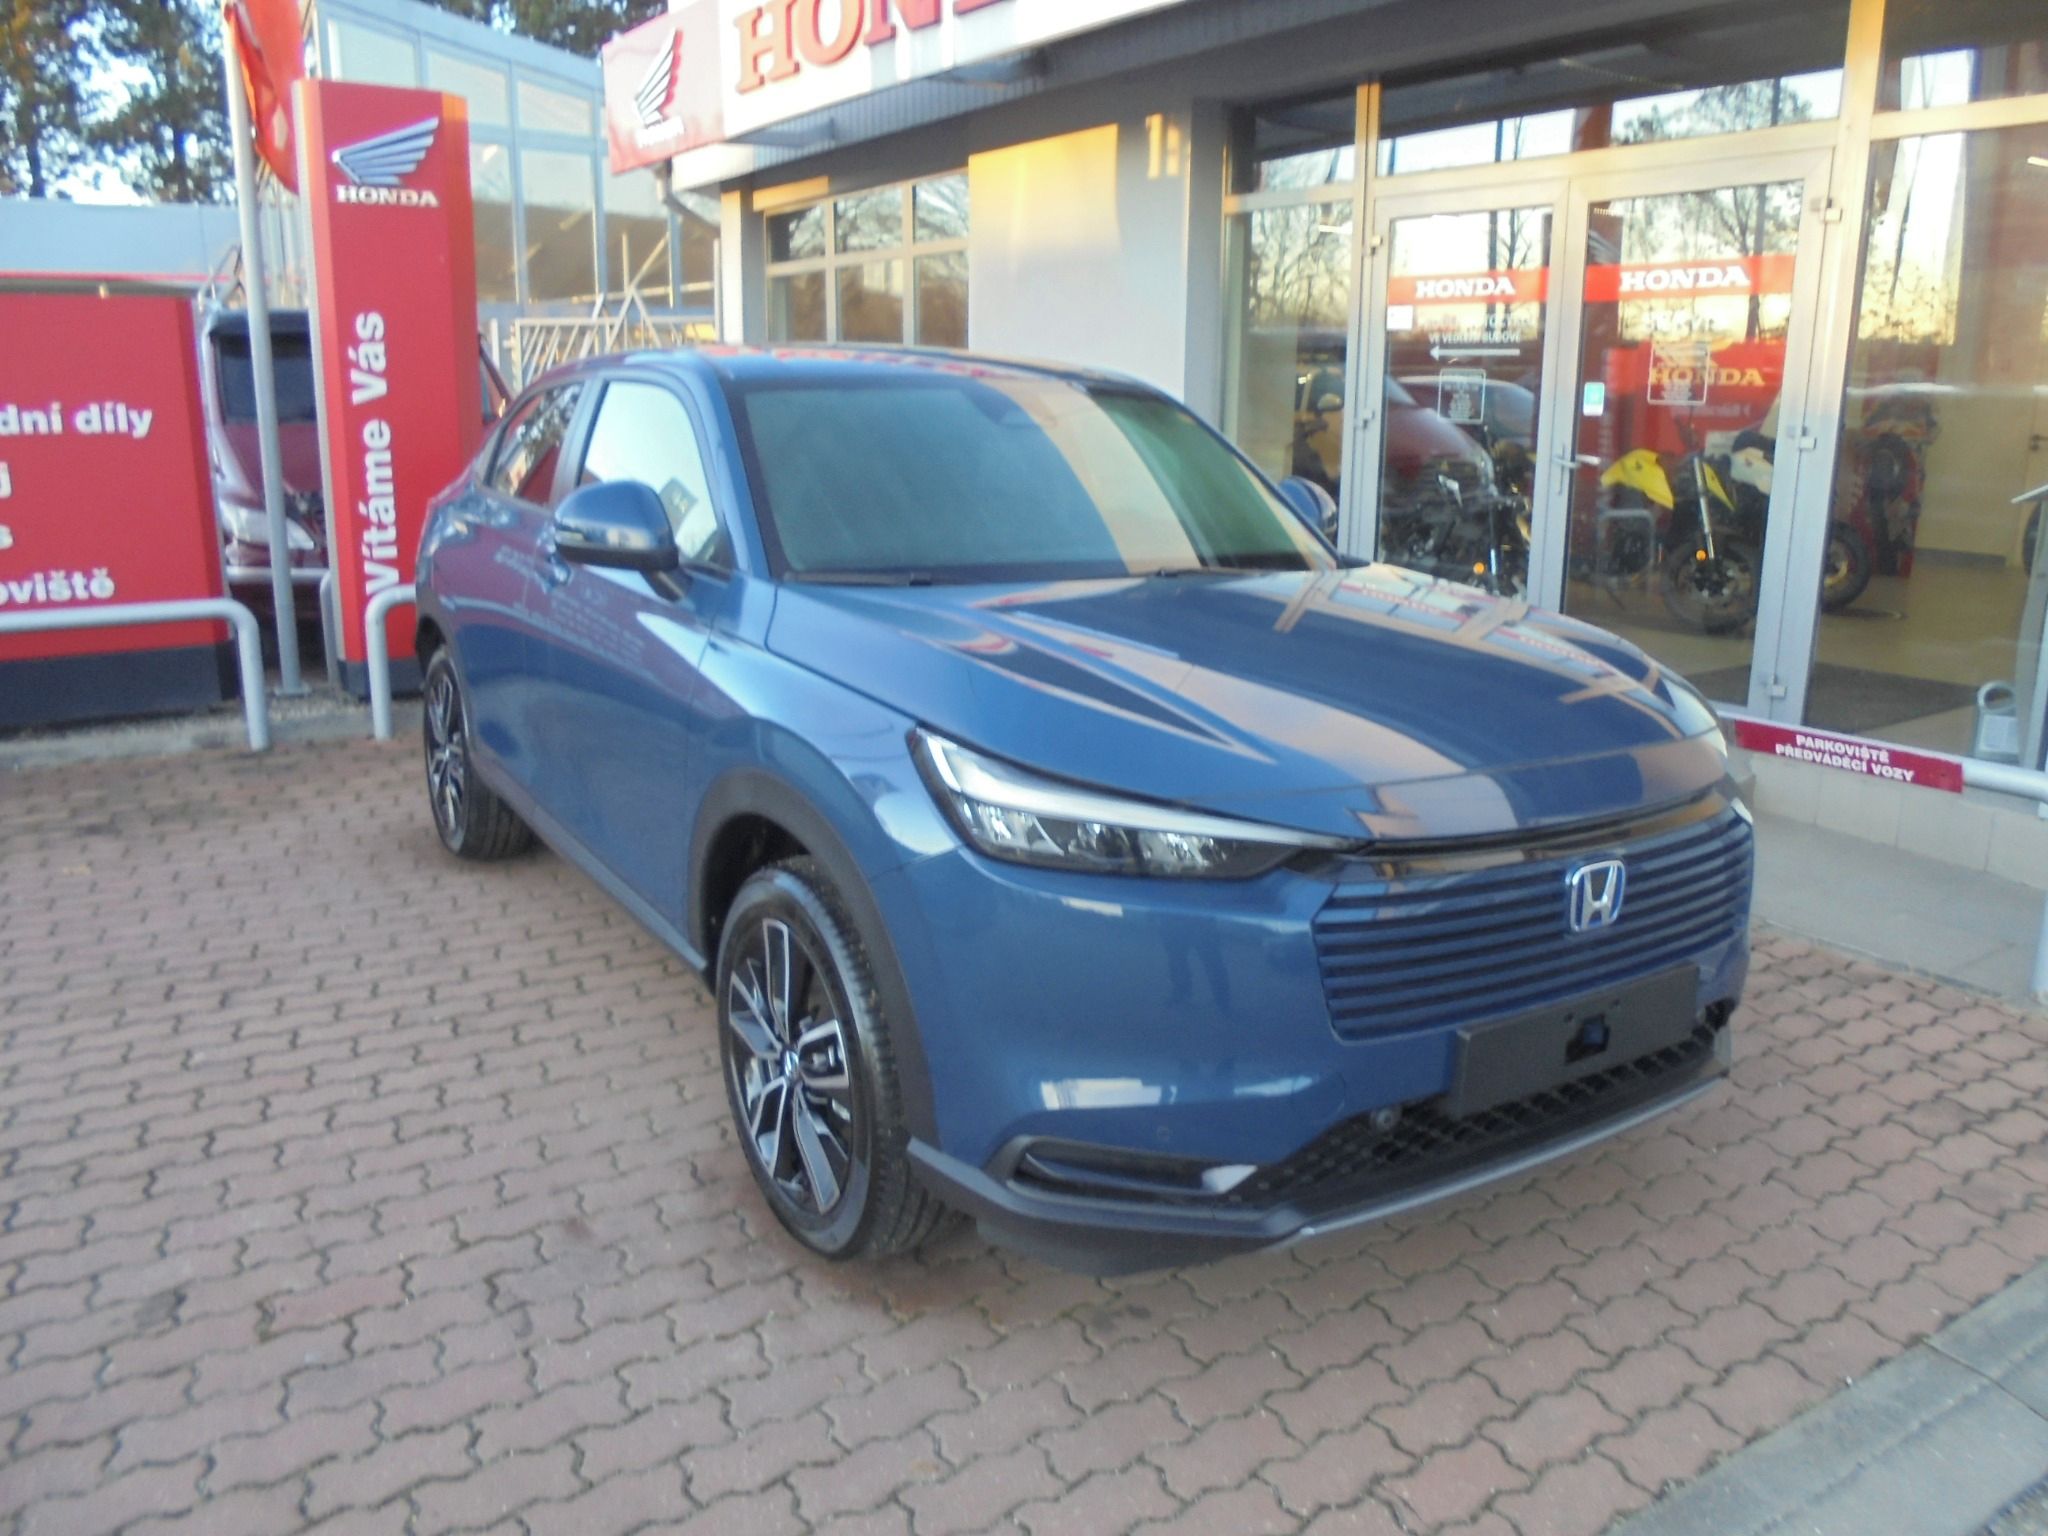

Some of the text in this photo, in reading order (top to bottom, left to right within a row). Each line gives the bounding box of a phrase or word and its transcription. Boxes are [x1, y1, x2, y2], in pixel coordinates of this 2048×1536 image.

[336, 184, 440, 208] HONDA
[1415, 276, 1516, 299] HONDA
[1620, 265, 1751, 292] HONDA
[1650, 367, 1766, 387] HONDA
[75, 402, 152, 439] díly
[348, 311, 400, 597] Vítáme Vás
[1775, 743, 1915, 782] PŘEDVÁDĚCÍ VOZY
[1795, 734, 1890, 763] PARKOVIŠTĚ
